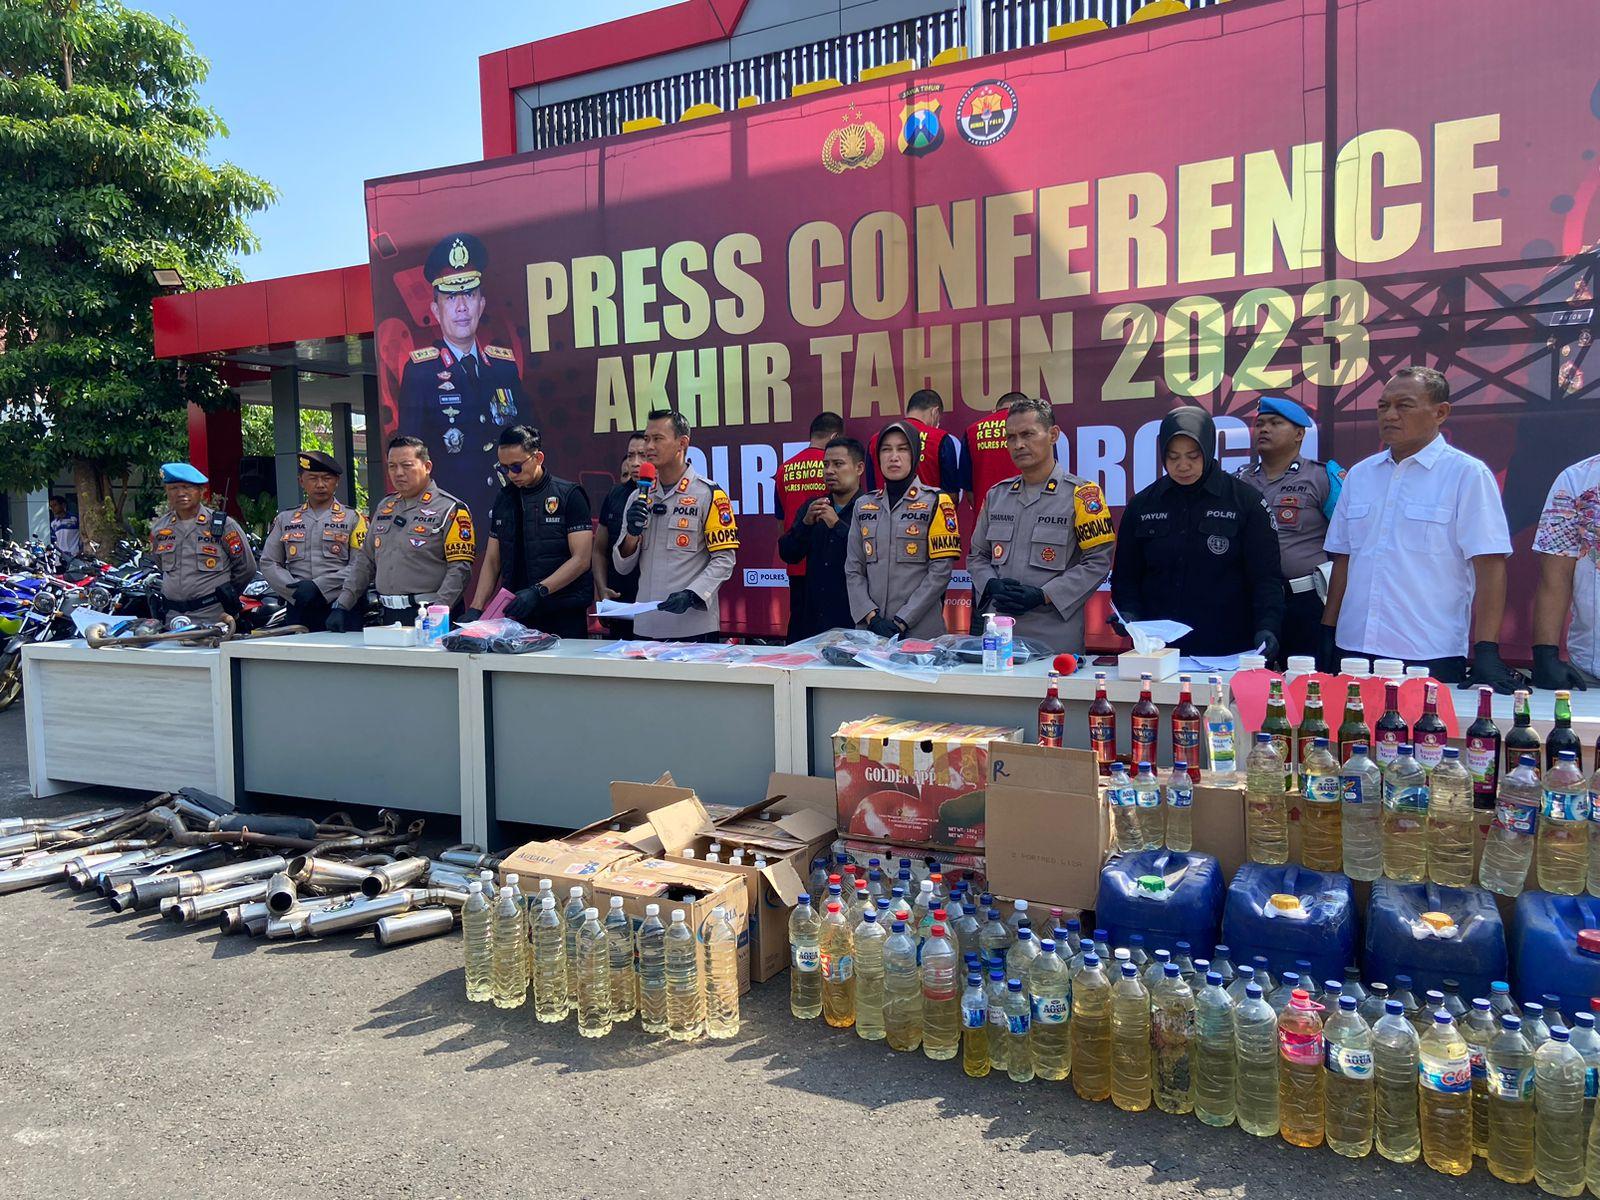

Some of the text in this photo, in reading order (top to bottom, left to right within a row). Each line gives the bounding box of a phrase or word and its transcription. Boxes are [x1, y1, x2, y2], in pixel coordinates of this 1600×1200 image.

[526, 113, 1503, 353] PRESS CONFERENCE
[593, 279, 1370, 434] AKHIR TAHUN 2023
[977, 419, 1006, 430] TAHA
[783, 469, 824, 482] RESMOB
[1281, 485, 1308, 493] POLRI
[673, 506, 698, 516] POLRI
[1206, 510, 1236, 520] POLRI
[900, 512, 930, 521] POLRI
[1037, 516, 1068, 525] POLRI
[1140, 512, 1168, 522] YAYUN
[864, 766, 909, 785] GOLDEN
[992, 760, 1010, 782] R
[1043, 1004, 1067, 1014] AQUA
[1344, 1054, 1372, 1065] AQUA
